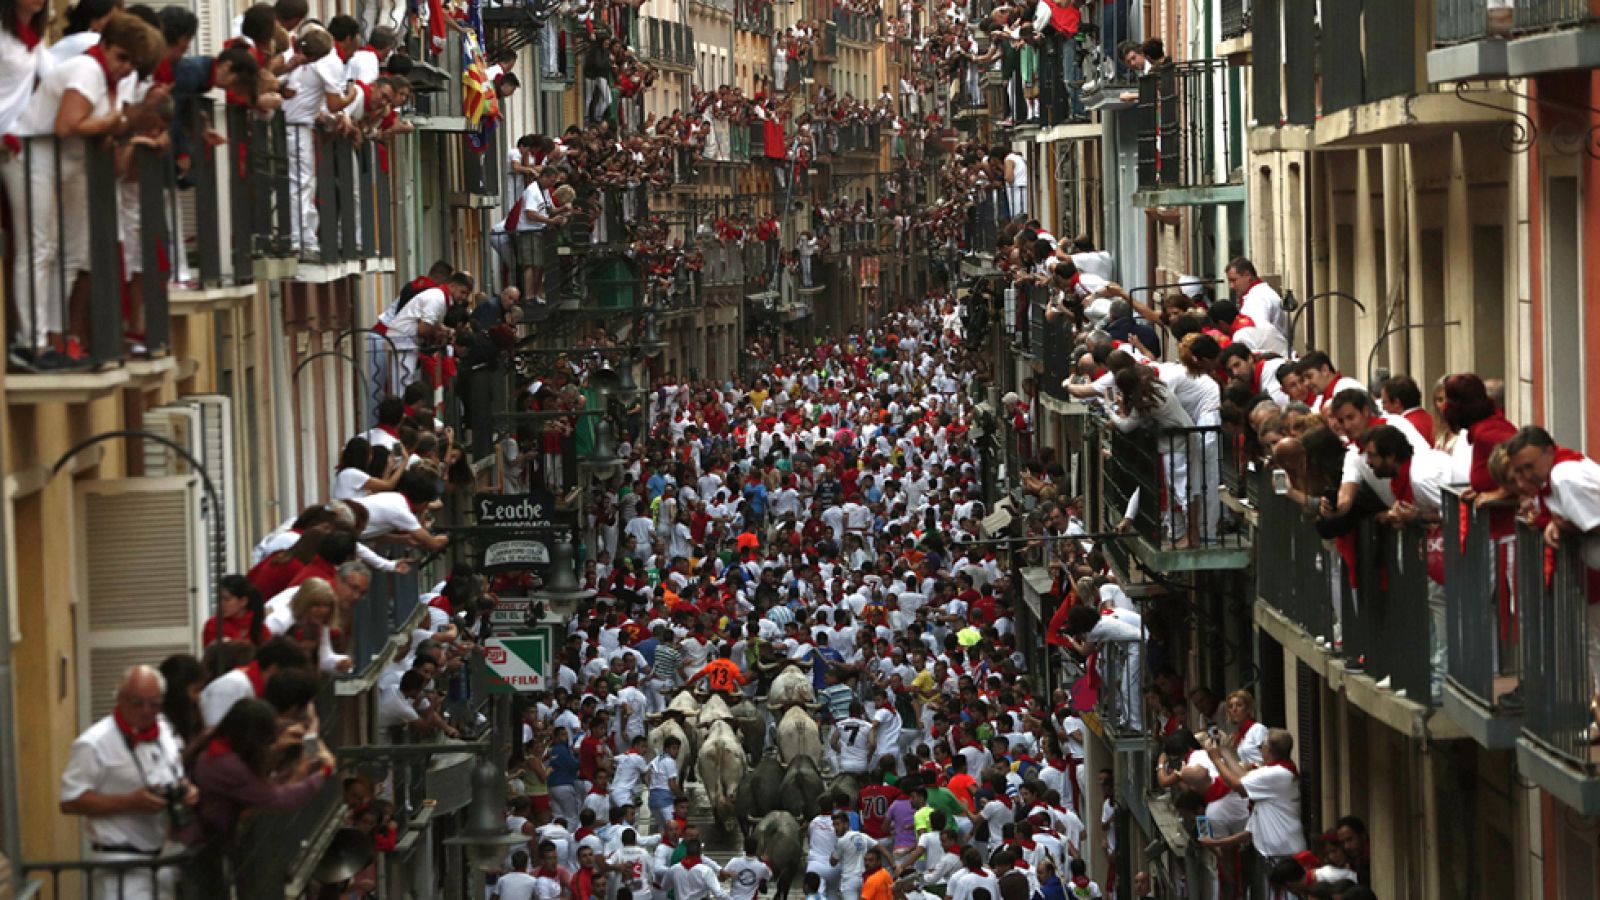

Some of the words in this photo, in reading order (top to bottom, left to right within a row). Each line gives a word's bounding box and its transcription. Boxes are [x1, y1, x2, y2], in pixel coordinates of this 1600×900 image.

[481, 498, 542, 520] Leache
[712, 667, 728, 685] 13
[844, 725, 859, 746] 7
[863, 795, 886, 818] 70
